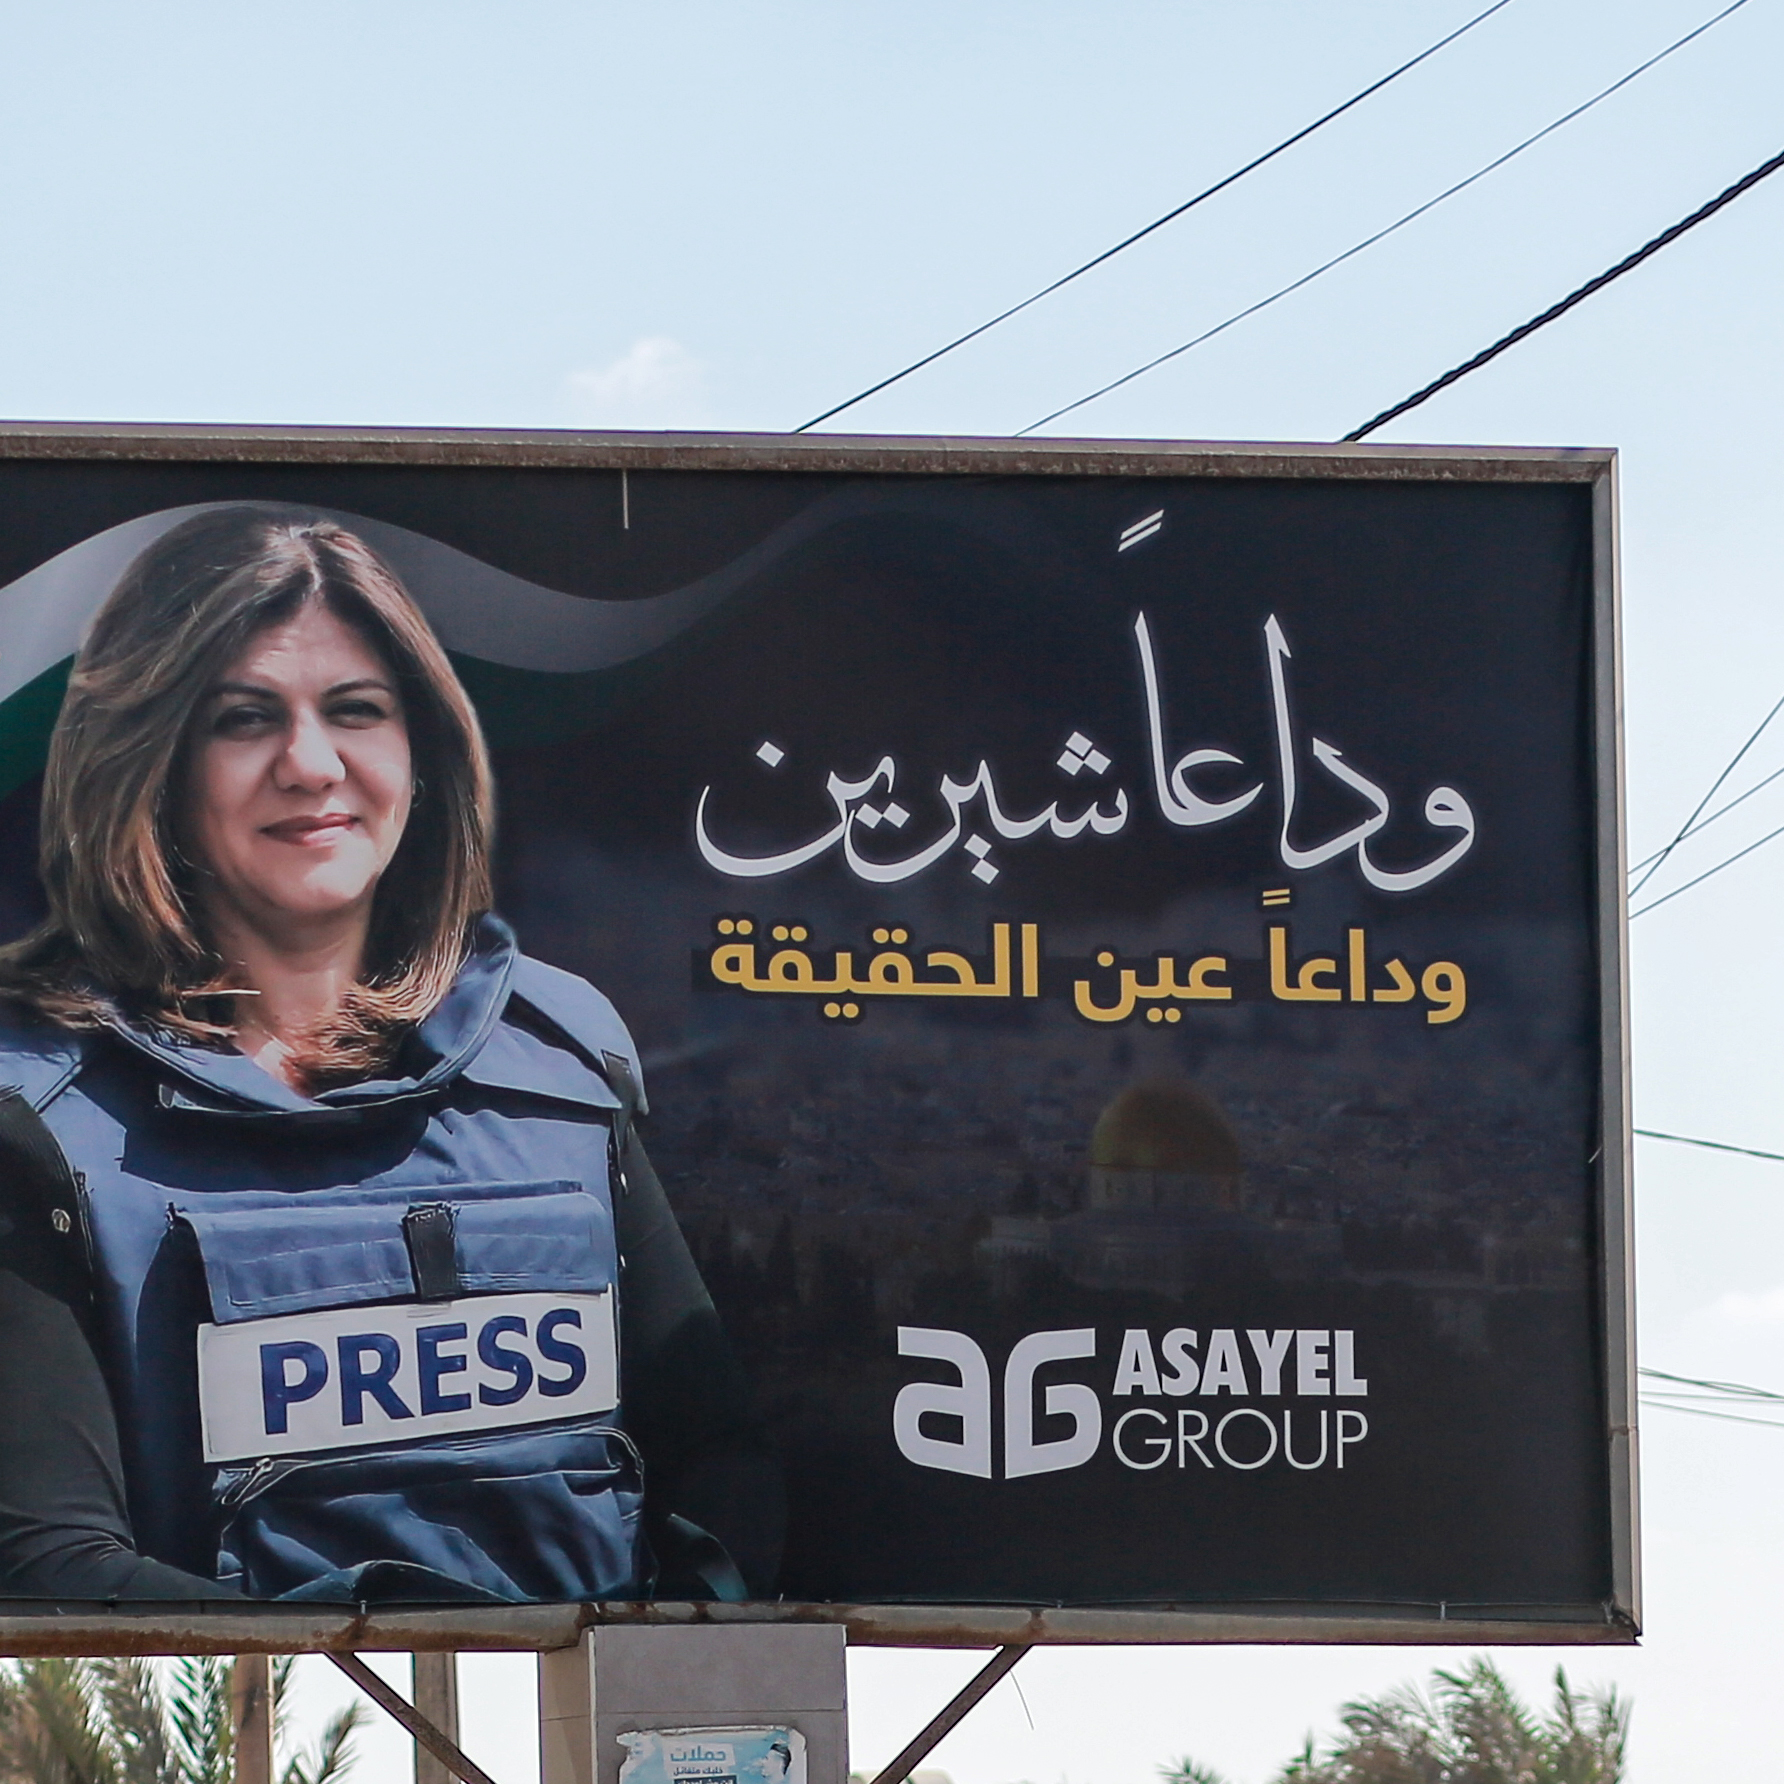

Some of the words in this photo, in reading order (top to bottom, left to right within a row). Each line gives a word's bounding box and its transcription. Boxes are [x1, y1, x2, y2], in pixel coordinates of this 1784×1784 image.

[694, 729, 1131, 885] شيرين
[710, 918, 1039, 1020] الحقيقة
[1073, 951, 1233, 1023] عين
[259, 1307, 587, 1436] PRESS
[1112, 1327, 1368, 1396] ASAYEL
[1112, 1407, 1368, 1471] GROUP
[669, 1745, 727, 1762] حملات
